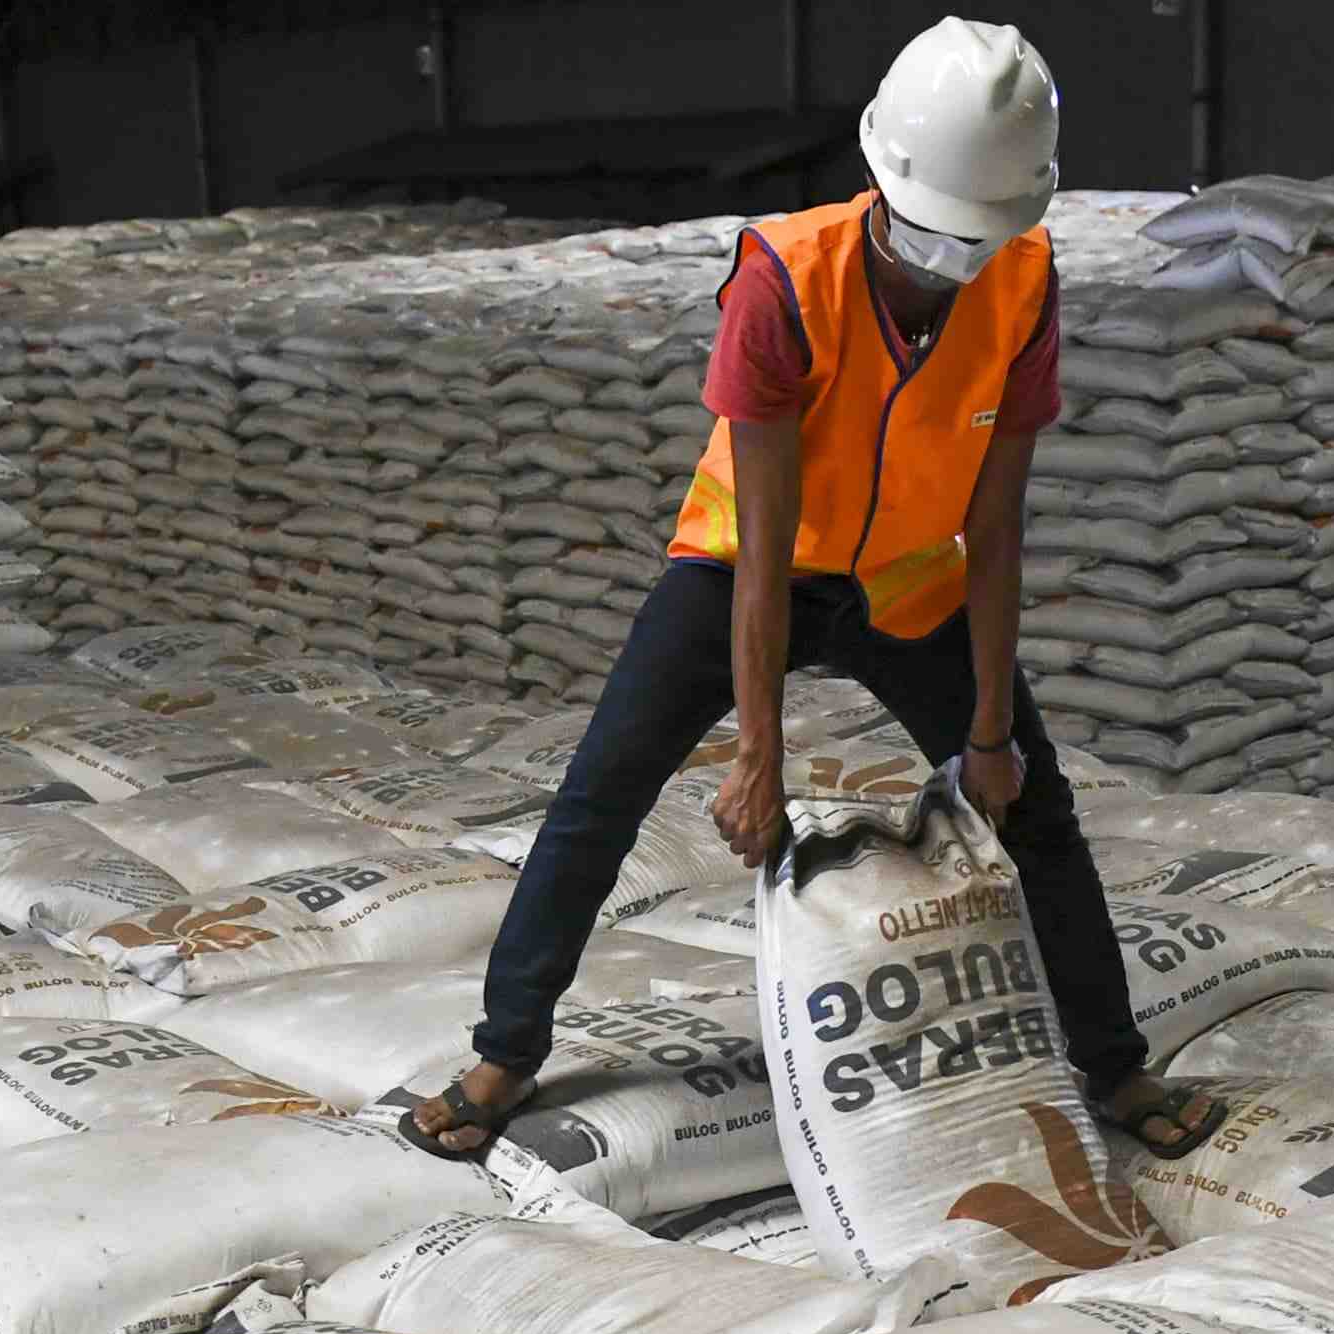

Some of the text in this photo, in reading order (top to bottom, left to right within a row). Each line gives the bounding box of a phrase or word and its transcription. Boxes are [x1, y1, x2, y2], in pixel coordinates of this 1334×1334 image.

[339, 882, 428, 928] BULOG BULOG
[878, 894, 959, 942] NETTO
[23, 976, 73, 991] BULOG
[806, 938, 1040, 1043] BULOG
[1135, 997, 1177, 1024] BULOG
[1180, 974, 1220, 1003] BULOG
[1222, 957, 1261, 980] BULOG
[554, 1010, 737, 1098] BULOG
[822, 1006, 1055, 1114] BERAS
[674, 1109, 772, 1141] BULOG BULOG
[776, 980, 857, 1242] BULOG BULOG BULOG BULOG
[1212, 1126, 1249, 1155] 50
[1185, 1173, 1230, 1197] BULOG
